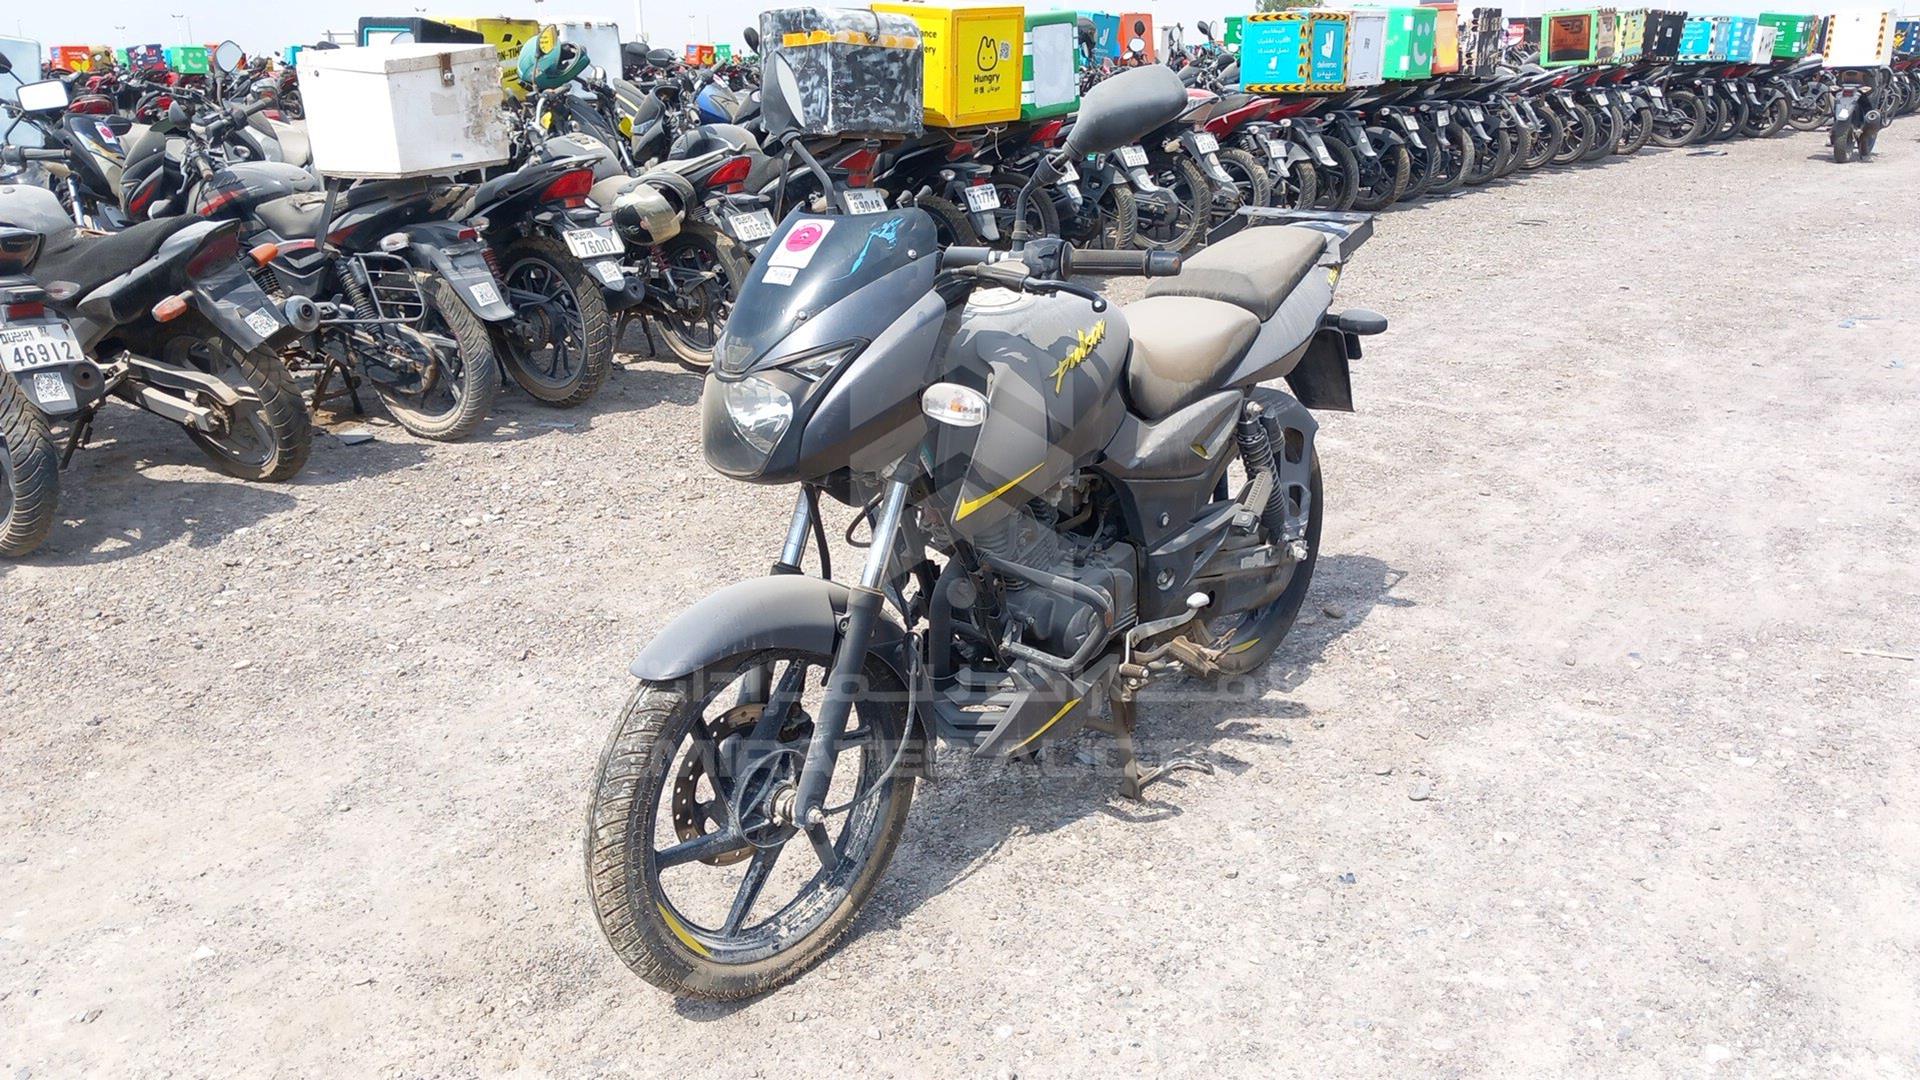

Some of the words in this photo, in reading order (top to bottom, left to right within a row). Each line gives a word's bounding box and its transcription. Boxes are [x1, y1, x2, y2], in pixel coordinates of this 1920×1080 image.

[973, 73, 1000, 85] Hungry
[580, 238, 617, 255] 76001
[13, 341, 75, 367] 46912
